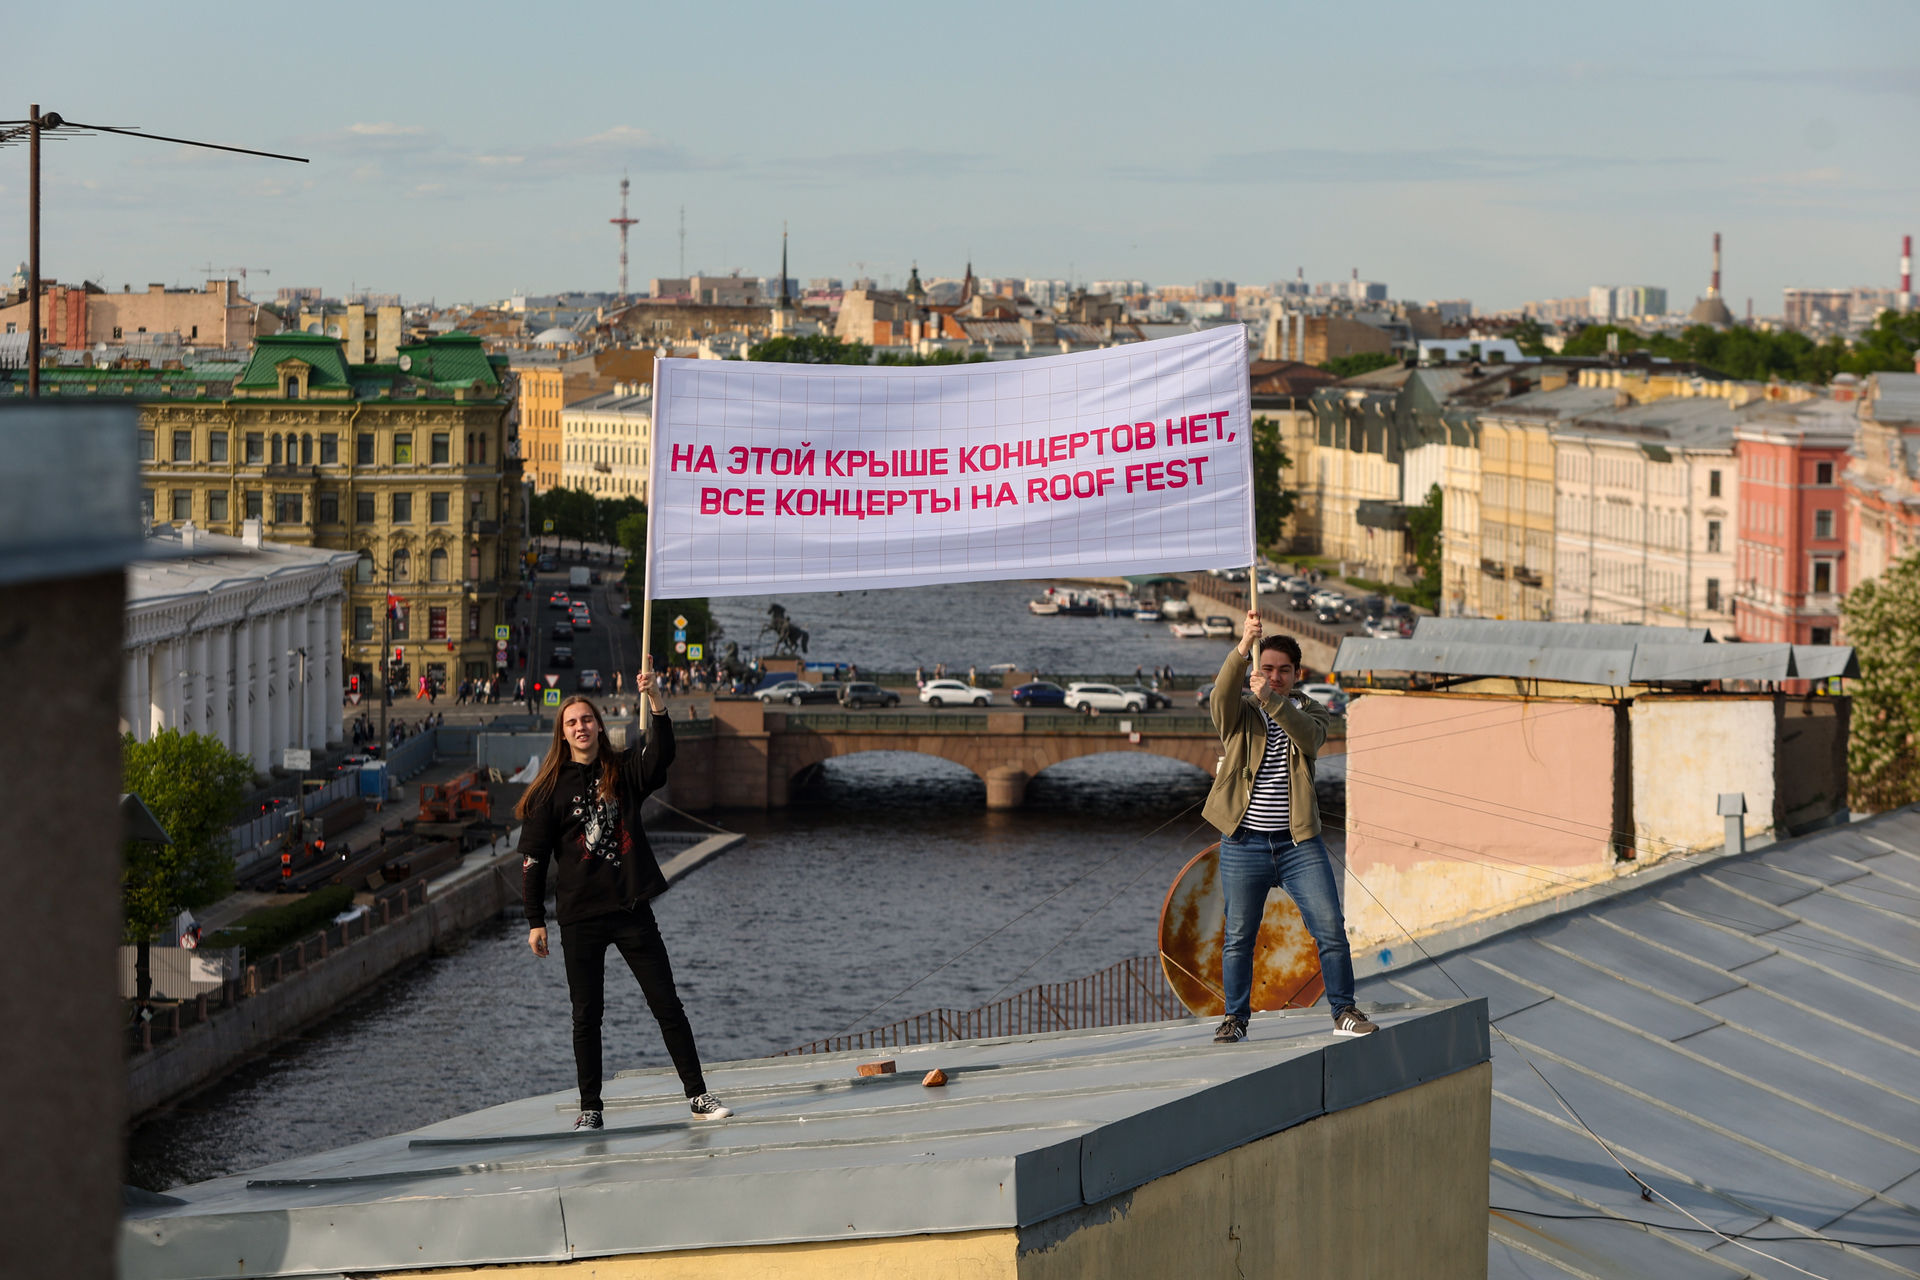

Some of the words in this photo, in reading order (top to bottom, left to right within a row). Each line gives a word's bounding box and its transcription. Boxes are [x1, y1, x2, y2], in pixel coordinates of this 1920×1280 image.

[670, 443, 719, 474] НА
[726, 441, 816, 477] ЭТОЙ
[825, 447, 949, 478] КРЫШЕ
[959, 421, 1157, 474] КОНЦЕРТОВ
[1165, 410, 1237, 447] НЕТ,
[700, 487, 766, 516] ВСЕ
[775, 487, 961, 521] КОНЦЕРТЫ
[971, 481, 1019, 510] НА
[1027, 467, 1115, 504] ROOF
[1124, 455, 1209, 494] FEST
